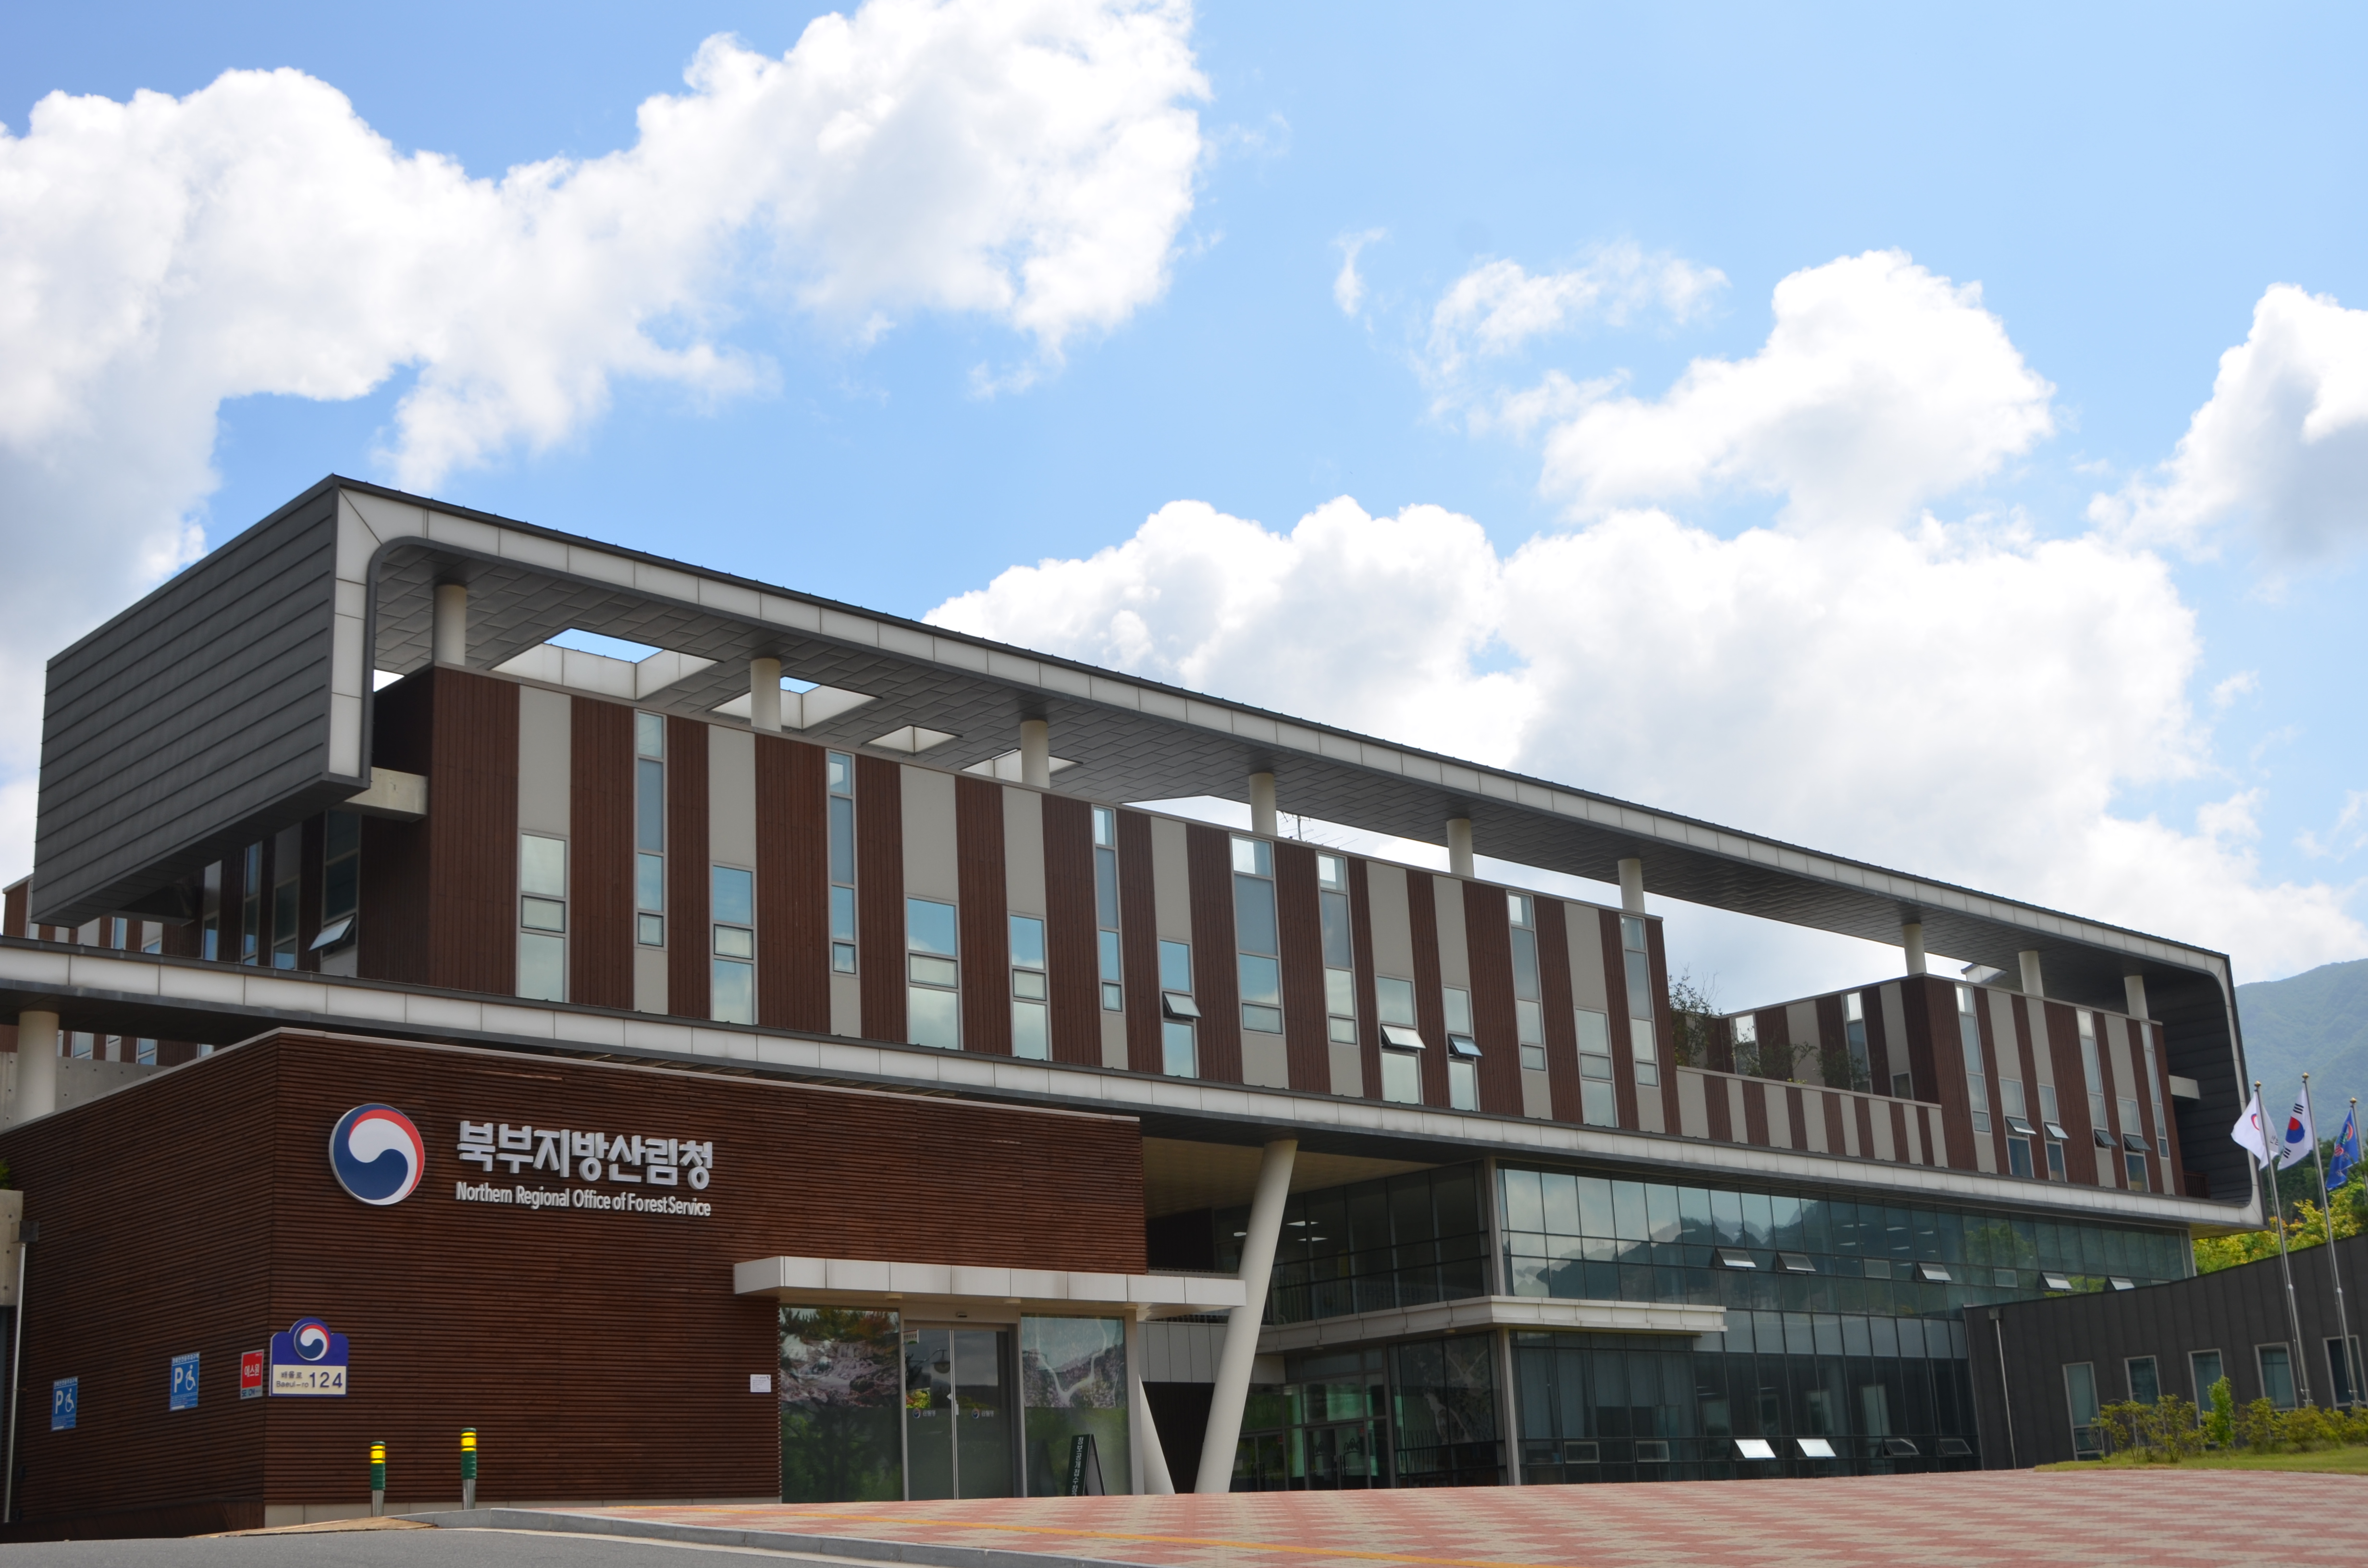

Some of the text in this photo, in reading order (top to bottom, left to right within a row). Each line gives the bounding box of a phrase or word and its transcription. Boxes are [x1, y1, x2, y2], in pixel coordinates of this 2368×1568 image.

[457, 1121, 713, 1190] 북부지방산림청
[456, 1181, 512, 1203] Northern
[516, 1185, 570, 1210] Regional
[572, 1189, 611, 1209] Office
[612, 1191, 626, 1210] of
[174, 1367, 183, 1393] P
[245, 1363, 259, 1377] 에스원
[309, 1372, 343, 1388] 124
[55, 1390, 63, 1414] P
